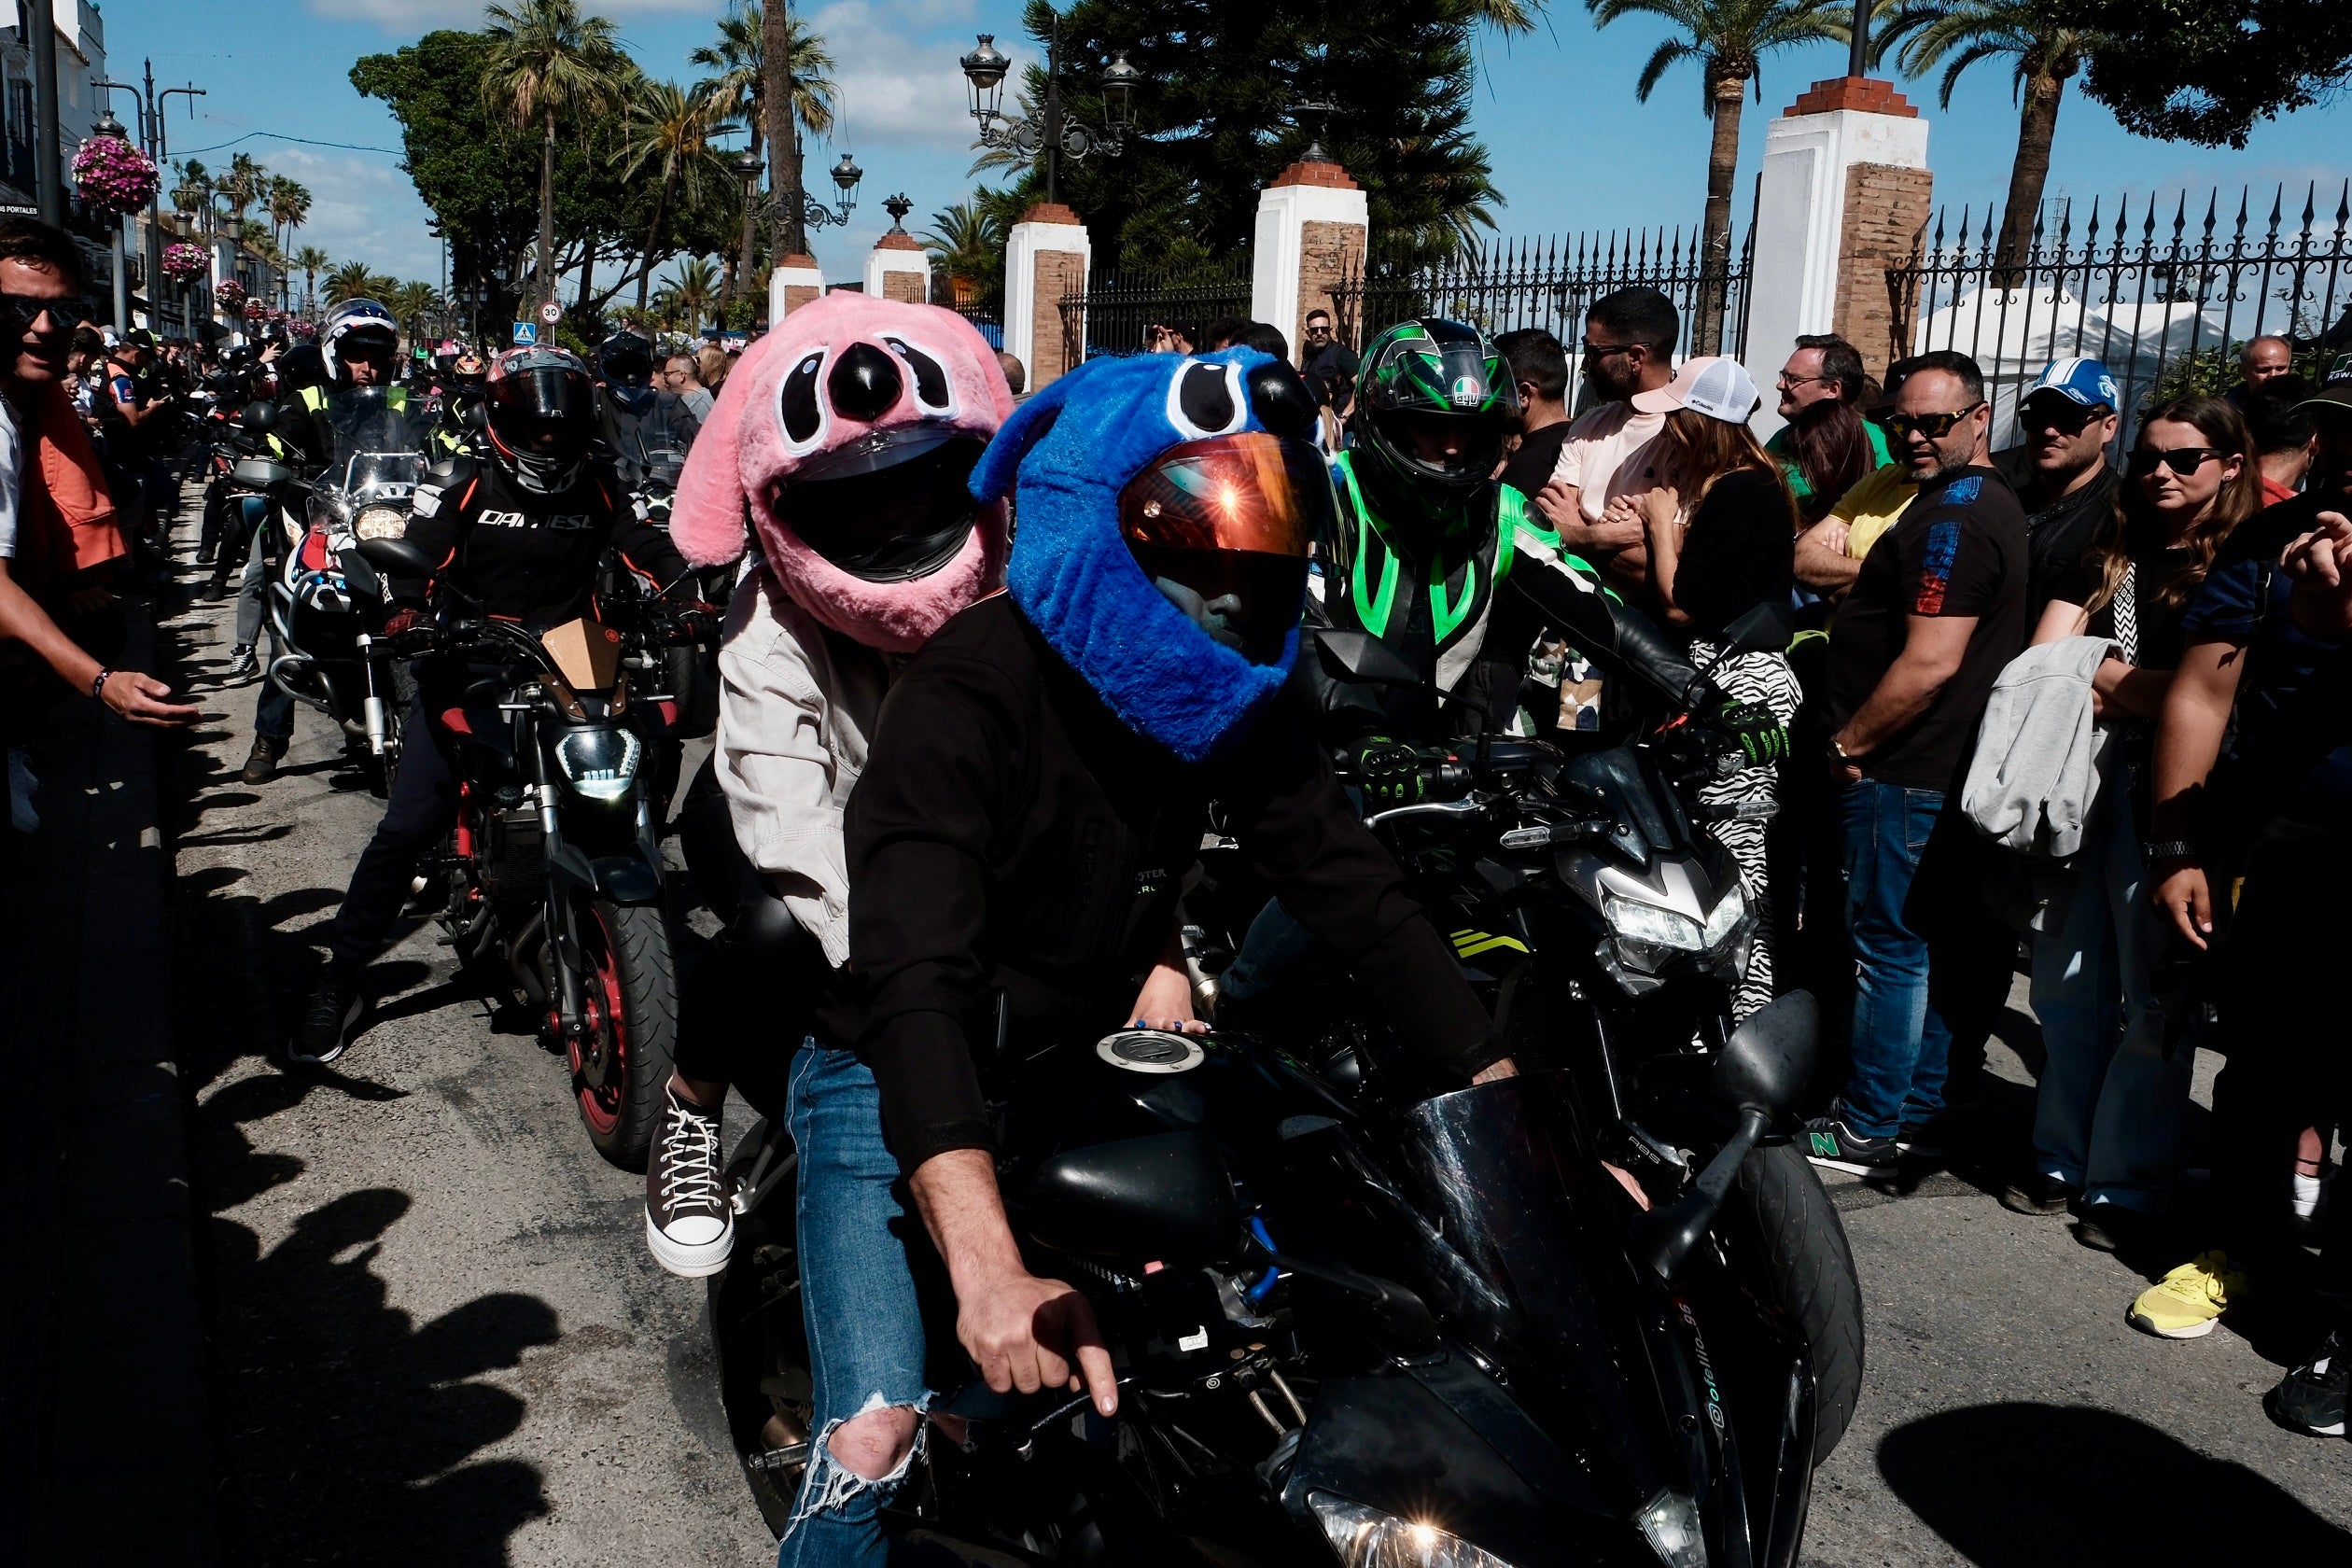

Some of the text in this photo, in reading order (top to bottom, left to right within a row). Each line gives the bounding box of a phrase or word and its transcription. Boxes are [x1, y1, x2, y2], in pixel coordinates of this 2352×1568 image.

[7, 206, 38, 215] PORTALES
[544, 308, 557, 316] 30
[1628, 1135, 1661, 1165] ABS
[1809, 1132, 1841, 1156] N
